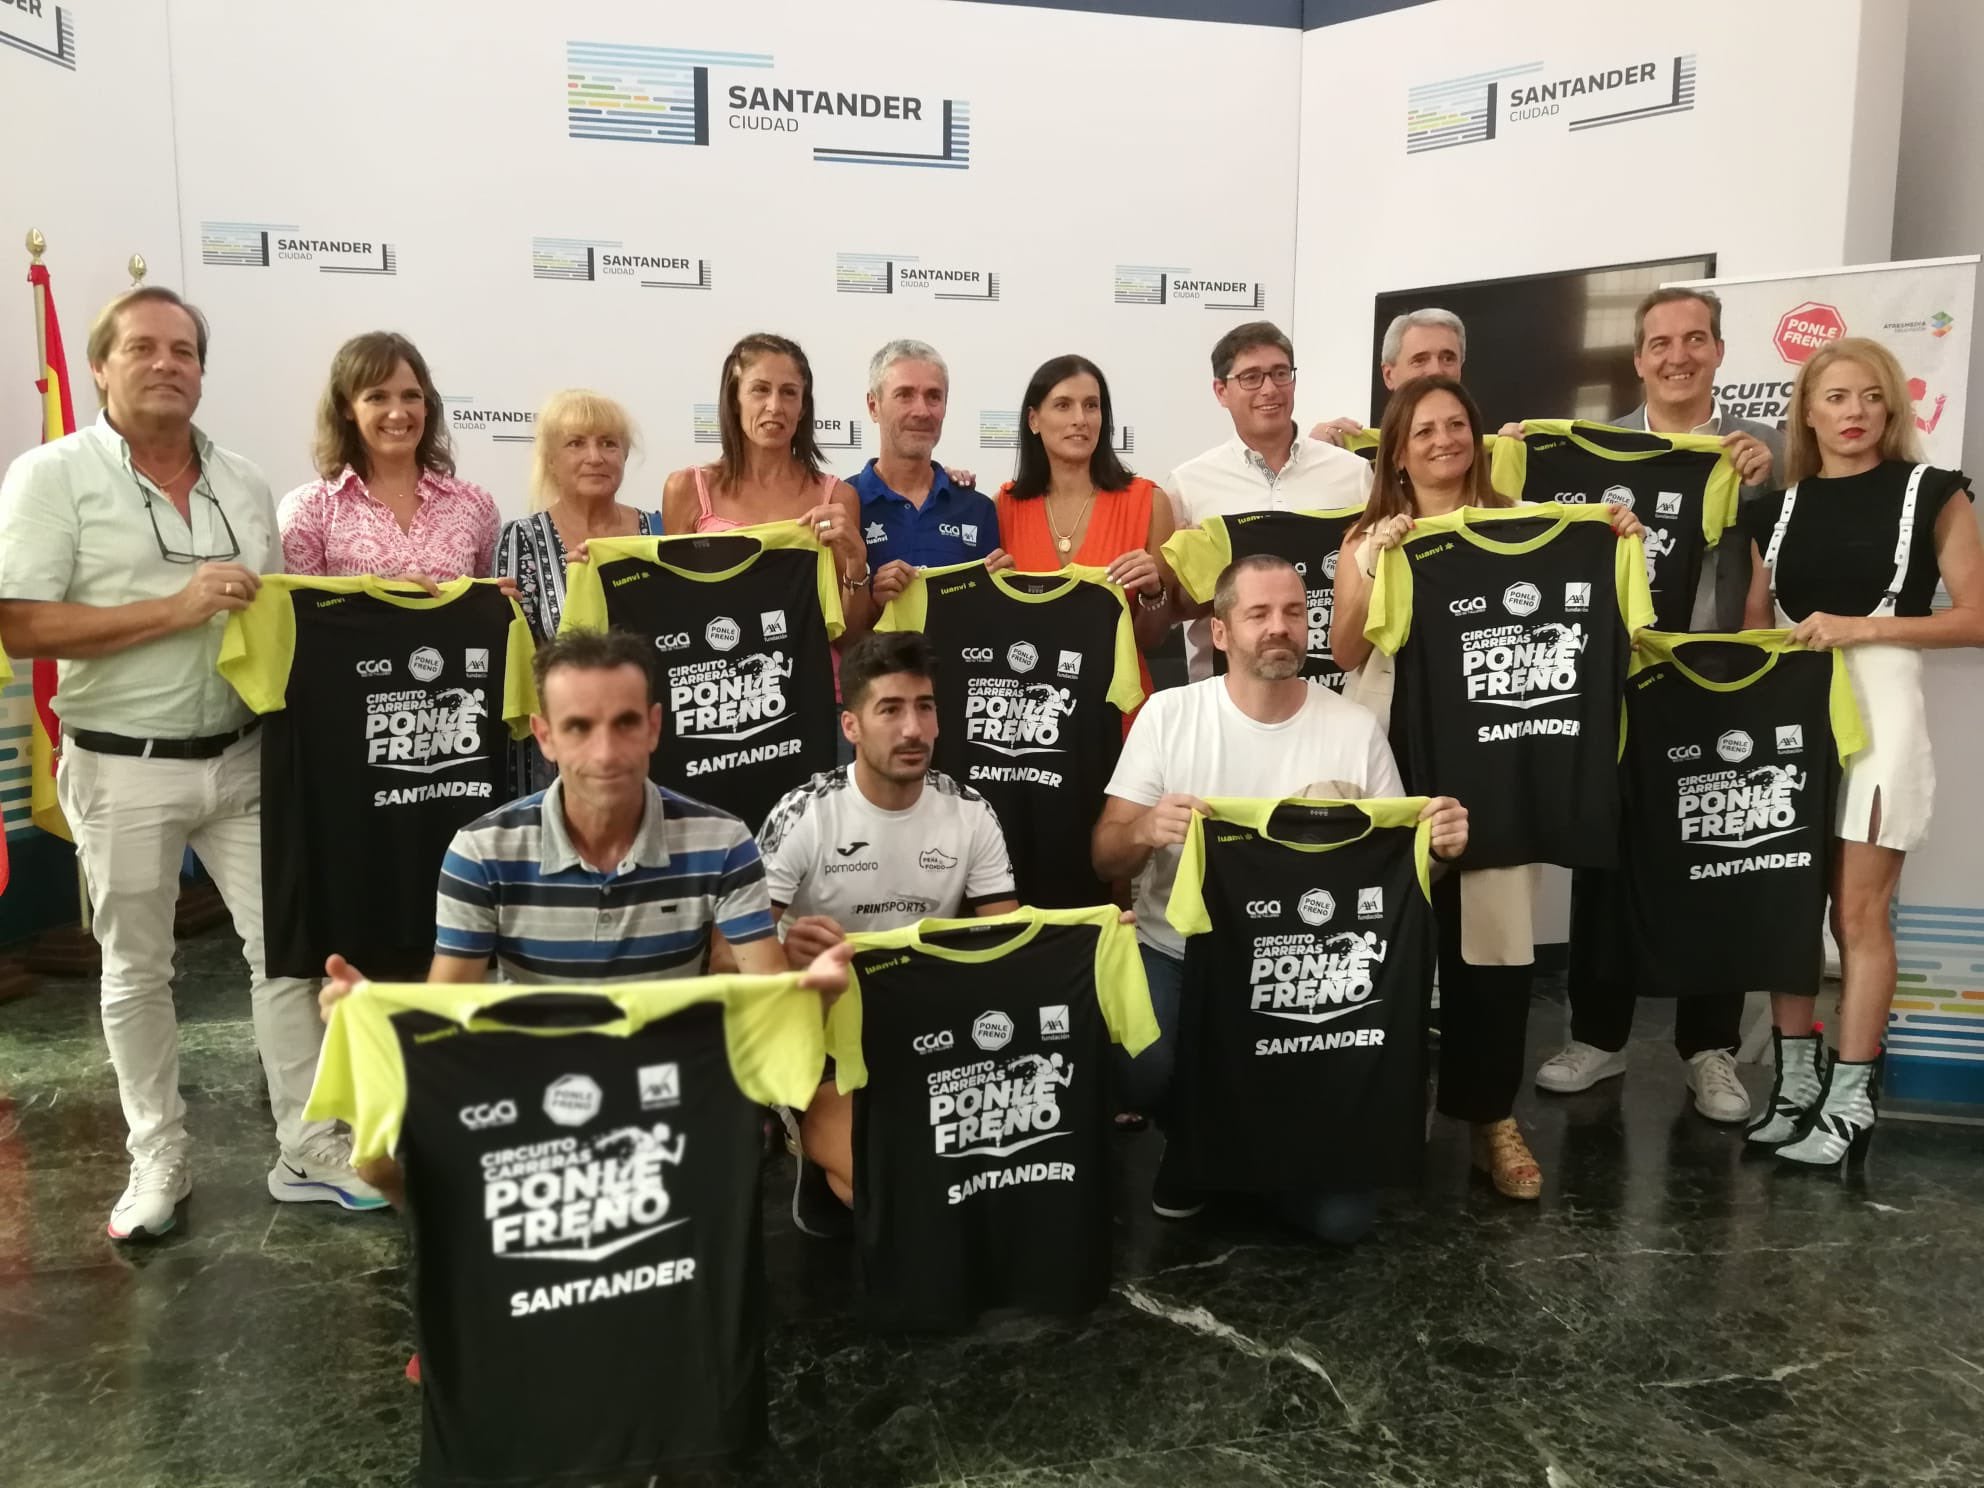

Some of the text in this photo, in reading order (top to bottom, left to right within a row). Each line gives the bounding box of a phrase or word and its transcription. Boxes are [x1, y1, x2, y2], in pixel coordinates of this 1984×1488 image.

[1510, 62, 1656, 107] SANTANDER
[728, 85, 922, 121] SANTANDER
[1509, 104, 1560, 122] CIUDAD
[728, 114, 799, 133] CIUDAD
[277, 239, 372, 254] SANTANDER
[278, 252, 313, 261] CIUDAD
[602, 254, 690, 270] SANTANDER
[602, 266, 635, 276] CIUDAD
[900, 268, 980, 282] SANTANDER
[900, 280, 930, 288] CIUDAD
[1173, 280, 1247, 293] SANTANDER
[1173, 291, 1200, 299] CIUDAD
[1787, 318, 1838, 338] PONLE
[453, 410, 538, 423] SANTANDE
[1415, 544, 1444, 561] luanvi
[612, 572, 641, 588] luanvi
[940, 582, 967, 595] luanvi
[1508, 597, 1535, 607] FRENO
[1510, 591, 1536, 600] PONLE
[710, 633, 735, 641] FRENO
[711, 626, 735, 635] PONLE
[1461, 624, 1523, 642] CIRCUITO
[1462, 632, 1532, 652] CARRERAS
[415, 656, 439, 667] PONLE
[1012, 654, 1032, 666] FRENO
[1013, 648, 1034, 660] PONLE
[1463, 642, 1575, 677] PONLE
[413, 663, 438, 673] FRENO
[668, 658, 727, 678] CIRCUITO
[670, 667, 736, 687] CARRERAS
[670, 669, 781, 712] PONLE
[968, 678, 1019, 688] CIRCUITO
[968, 687, 1024, 697] CARRERAS
[1467, 667, 1576, 700] FRENO
[366, 689, 426, 704] CIRCUITO
[367, 698, 434, 713] CARRERAS
[676, 693, 786, 736] FRENO
[965, 696, 1059, 722] PONLE
[365, 706, 478, 740] PONLE
[967, 719, 1059, 745] FRENO
[1477, 718, 1581, 742] SANTANDER
[368, 731, 480, 764] FRENO
[1721, 745, 1747, 753] FRENO
[1722, 739, 1749, 747] PONLE
[686, 739, 802, 777] SANTANDER
[969, 766, 1063, 788] SANTANDER
[1677, 769, 1737, 787] CIRCUITO
[374, 782, 492, 807] SANTANDER
[1678, 778, 1746, 796] CARRERAS
[1677, 784, 1792, 818] PONLE
[1682, 805, 1796, 841] FRENO
[825, 860, 878, 875] pomodoro
[1690, 852, 1811, 880] SANTANDER
[1303, 905, 1328, 917] FRENO
[1305, 897, 1331, 910] PONLE
[1253, 933, 1315, 948] CIRCUITO
[1253, 943, 1324, 958] CARRERAS
[865, 958, 898, 975] luanvi
[1249, 953, 1371, 984] PONLE
[1250, 976, 1374, 1010] FRENO
[978, 1029, 1007, 1039] FRENO
[979, 1022, 1008, 1031] PONLE
[1255, 1029, 1385, 1056] SANTANDER
[927, 1060, 995, 1085] CIRCUITO
[929, 1070, 1005, 1096] CARRERAS
[554, 1089, 593, 1101] PONLE
[930, 1079, 1056, 1125] PONLE
[552, 1098, 592, 1111] FRENO
[935, 1102, 1061, 1153] FRENO
[480, 1137, 577, 1168] CIRCUITO
[484, 1149, 592, 1182] CARRERAS
[485, 1154, 662, 1219] PONLE
[948, 1162, 1076, 1205] SANTANDER
[493, 1187, 670, 1254] FRENO
[510, 1258, 696, 1317] SANTANDER
